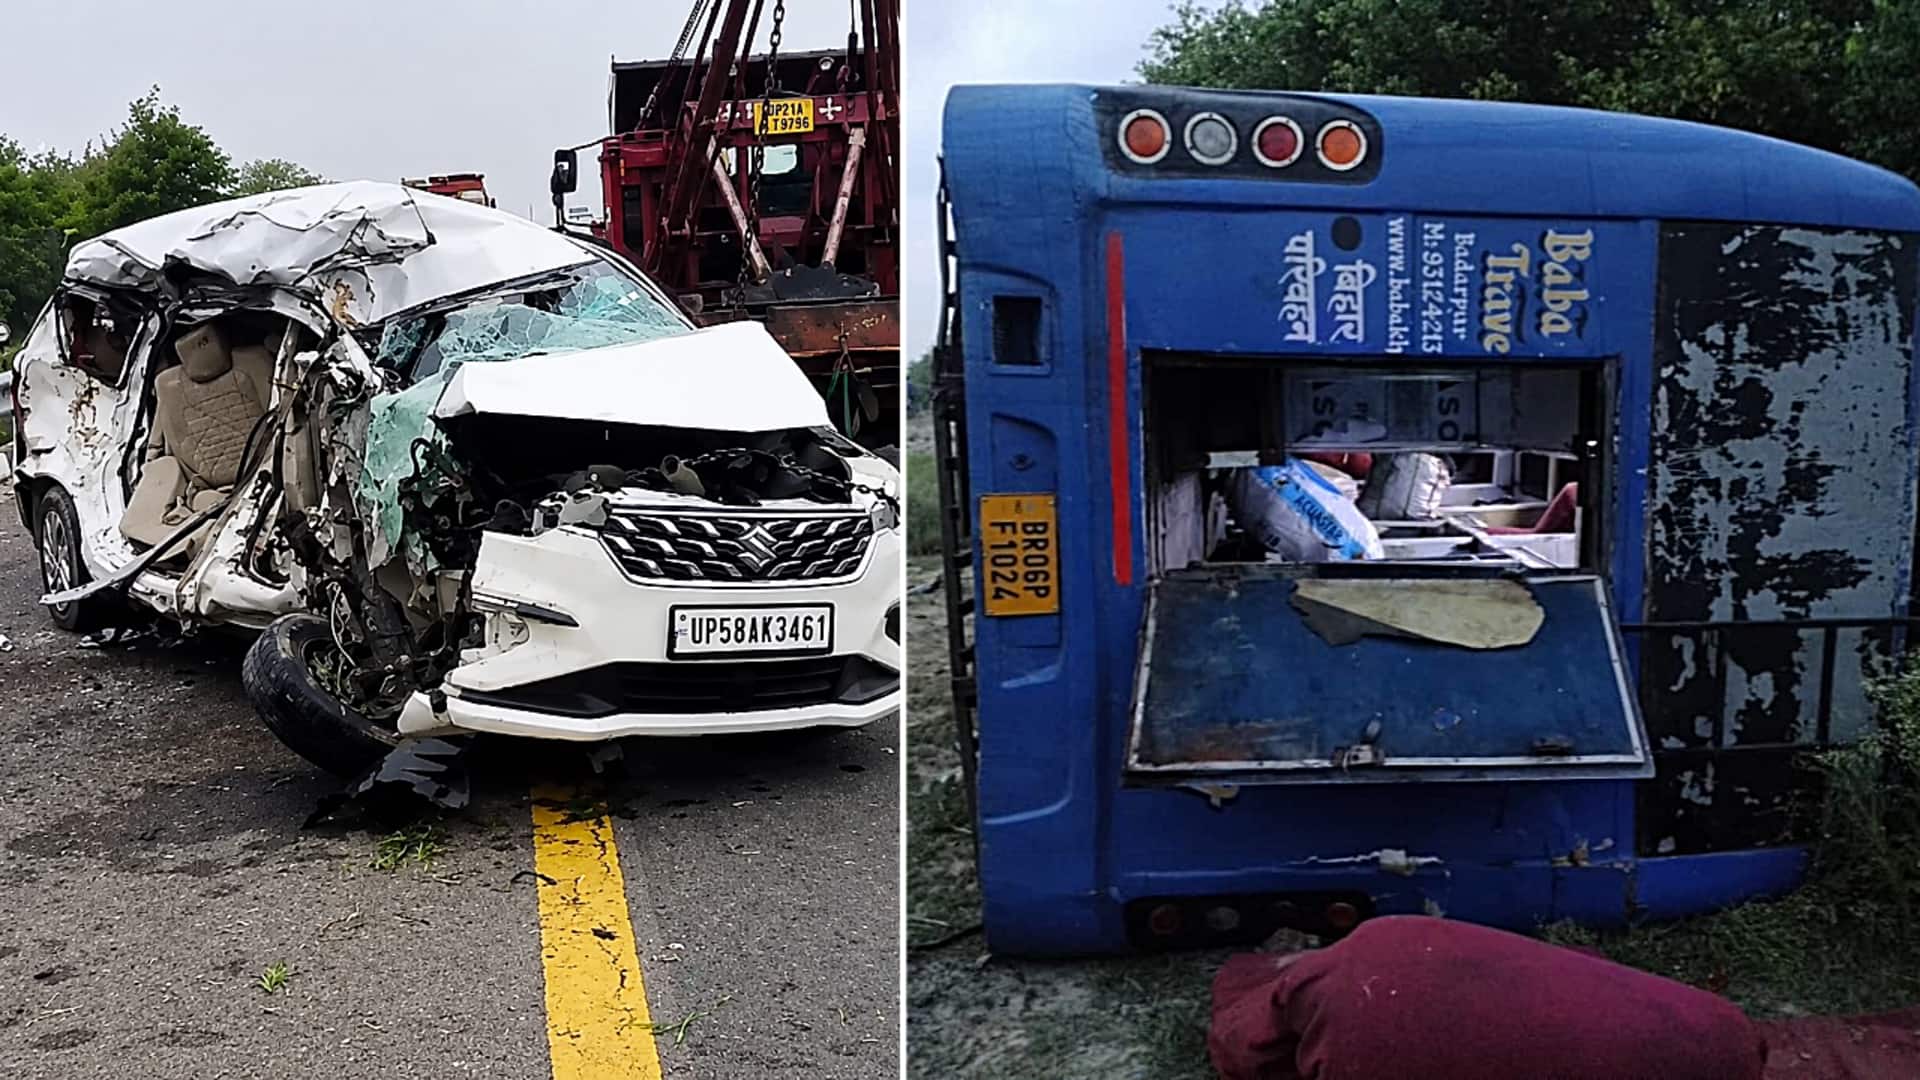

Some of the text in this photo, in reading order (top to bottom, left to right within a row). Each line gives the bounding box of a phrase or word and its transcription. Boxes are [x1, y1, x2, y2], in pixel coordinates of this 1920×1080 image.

[773, 117, 809, 131] T9796
[1278, 229, 1326, 343] परिवहन
[1327, 258, 1376, 343] बिहार
[1450, 232, 1475, 341] Badarpur
[1483, 242, 1532, 353] Trave
[1541, 228, 1594, 337] Baba
[989, 521, 1020, 600] F1024
[1022, 521, 1051, 598] BR06P
[691, 614, 825, 645] UP58AK3461
